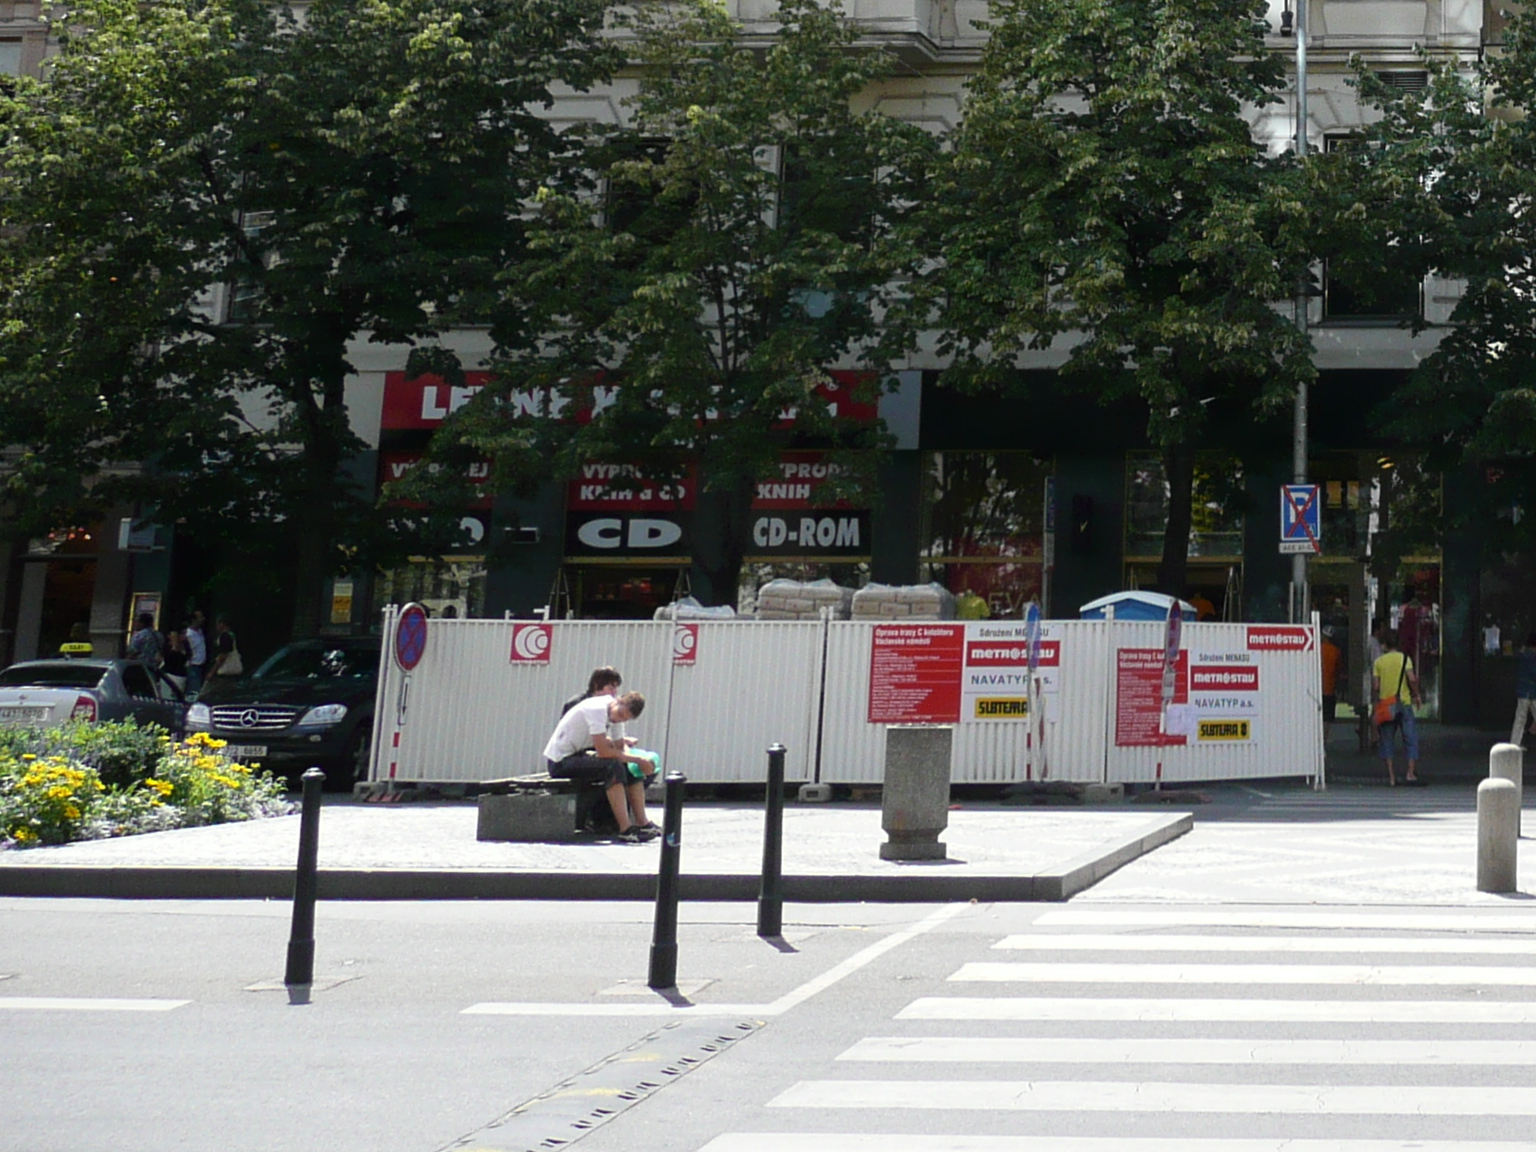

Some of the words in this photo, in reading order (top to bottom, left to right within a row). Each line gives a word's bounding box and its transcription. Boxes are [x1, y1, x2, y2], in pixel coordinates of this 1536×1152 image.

[757, 483, 811, 500] KNIH
[577, 518, 682, 549] CD
[752, 517, 861, 548] CD-ROM
